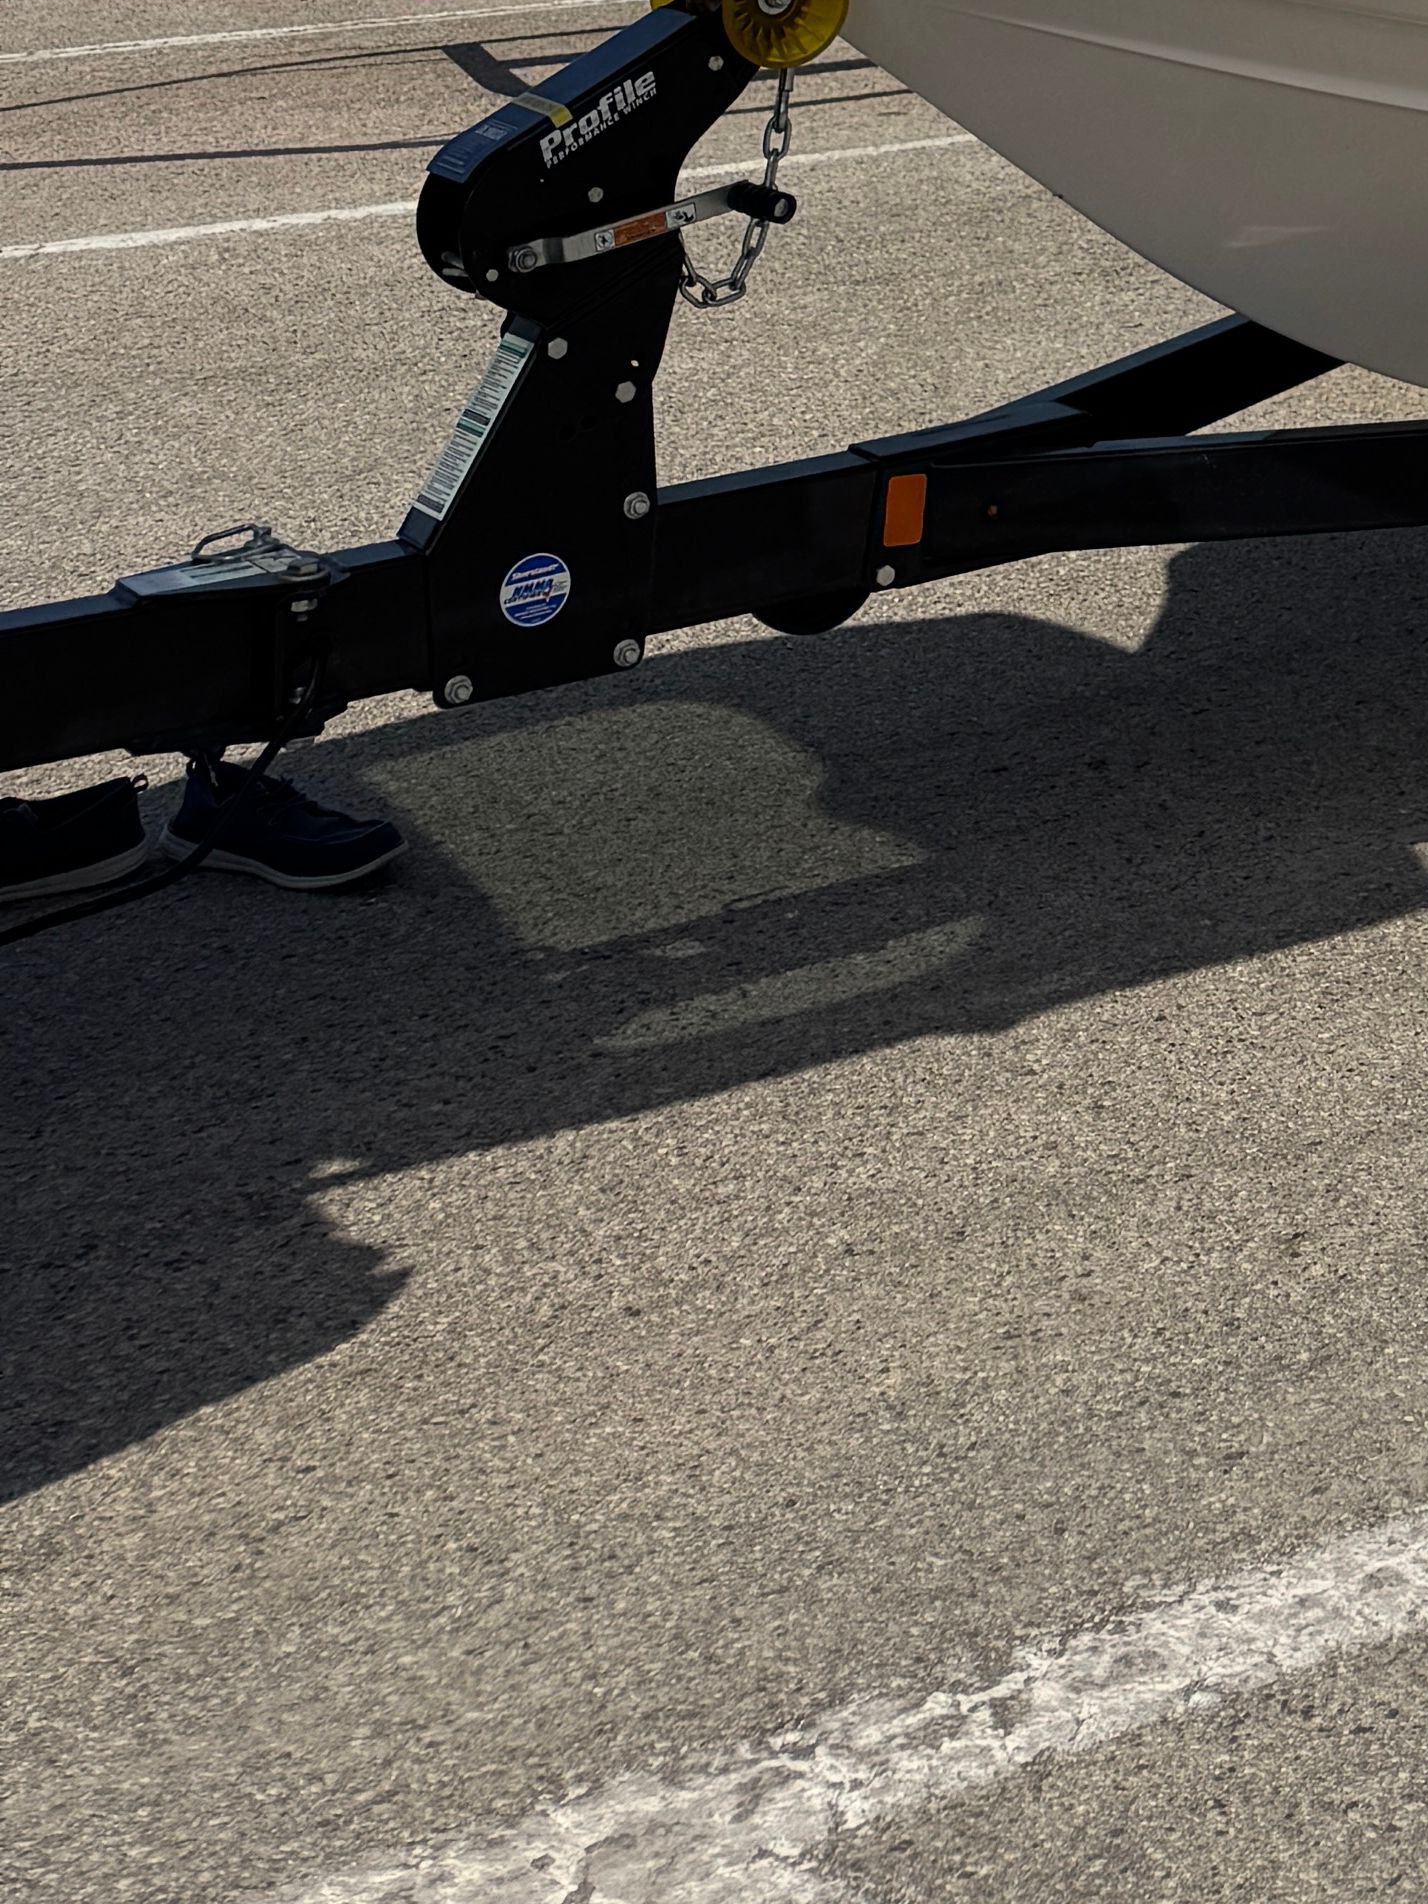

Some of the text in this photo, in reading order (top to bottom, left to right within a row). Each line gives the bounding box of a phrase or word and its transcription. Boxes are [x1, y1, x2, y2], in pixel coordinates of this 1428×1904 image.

[539, 71, 656, 162] Profile
[546, 113, 620, 169] PERFORMANCE
[623, 82, 657, 116] WINCH
